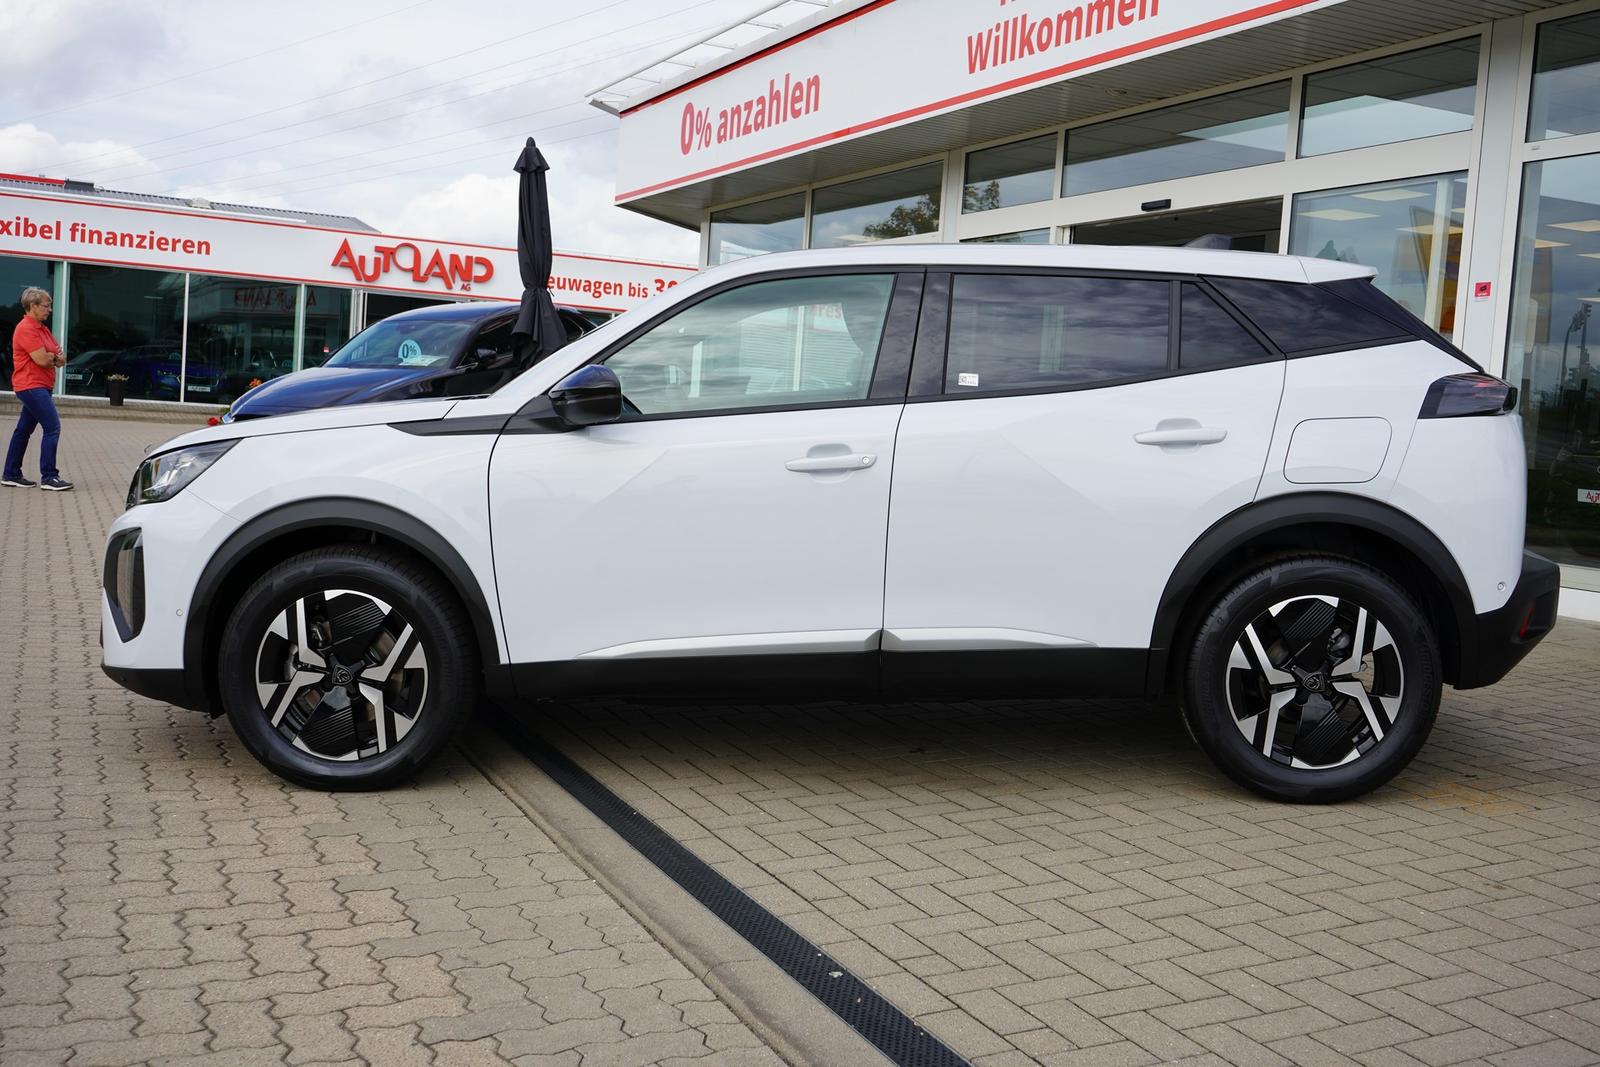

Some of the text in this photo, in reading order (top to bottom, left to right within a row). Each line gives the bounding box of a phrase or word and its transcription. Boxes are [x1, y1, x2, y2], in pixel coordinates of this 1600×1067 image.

[967, 0, 1160, 74] Willkommen
[680, 73, 820, 155] 0% anzahlen
[0, 216, 211, 256] xibel finanzieren
[331, 237, 494, 290] AUTOLAND
[460, 283, 471, 292] AG
[547, 276, 623, 299] euwagen
[628, 282, 649, 298] bis
[402, 343, 418, 359] 0%
